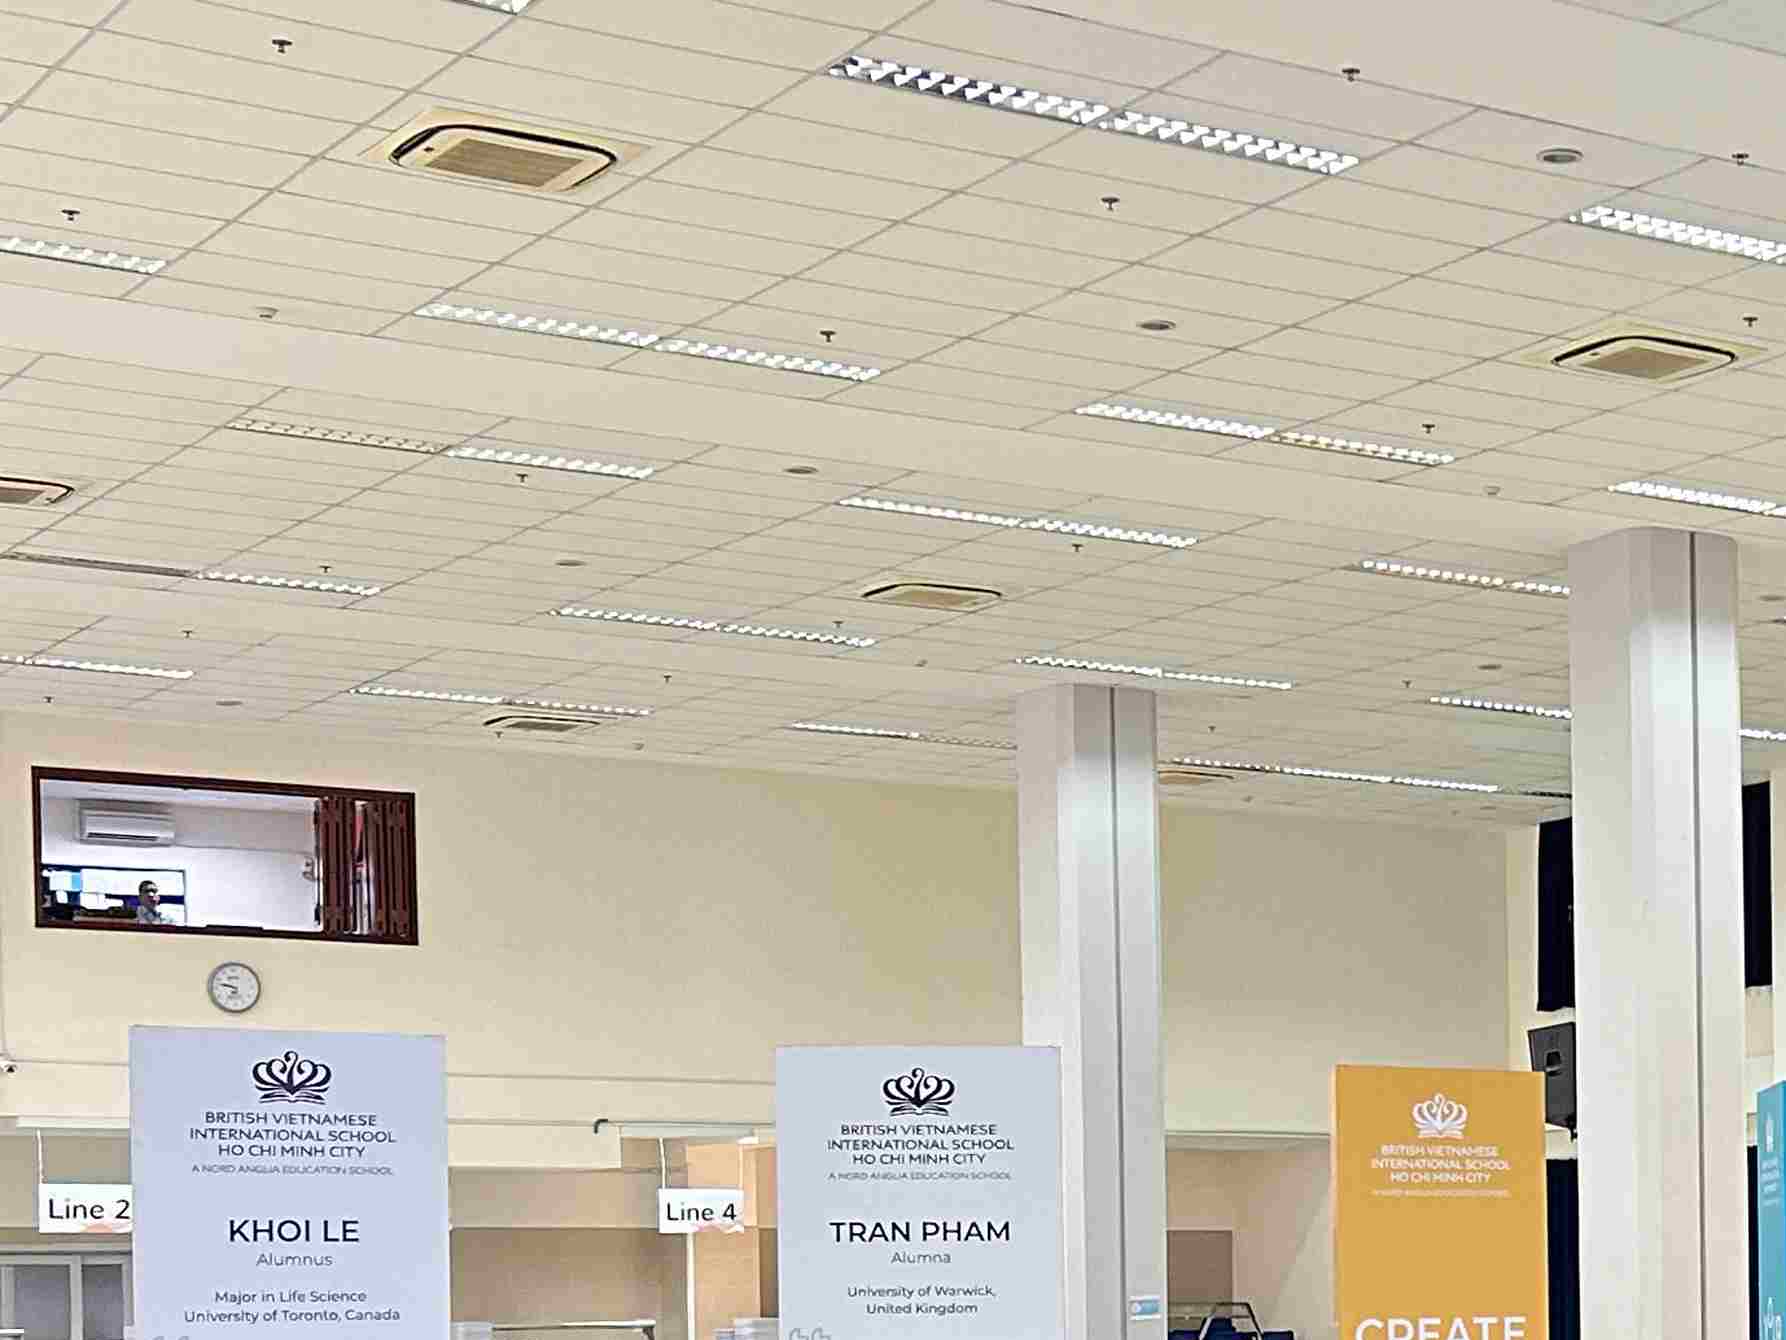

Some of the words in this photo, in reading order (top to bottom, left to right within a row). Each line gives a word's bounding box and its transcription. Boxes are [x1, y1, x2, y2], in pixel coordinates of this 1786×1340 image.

[205, 1111, 268, 1125] BRITISH
[272, 1113, 377, 1126] VIETNAMESE
[190, 1128, 325, 1141] INTERNATIONAL
[328, 1130, 398, 1143] SCHOOL
[841, 1124, 897, 1135] BRITISH
[900, 1124, 998, 1136] VIETNAMESE
[218, 1144, 245, 1156] HO
[249, 1145, 277, 1156] CHI
[280, 1146, 325, 1157] MINH
[329, 1146, 366, 1158] CITY
[827, 1139, 949, 1150] INTERNATIONAL
[952, 1139, 1015, 1151] SCHOOL
[853, 1154, 876, 1165] HO
[880, 1154, 905, 1165] CHI
[909, 1154, 950, 1165] MINH
[952, 1153, 986, 1165] CITY
[48, 1197, 105, 1220] Line
[115, 1198, 131, 1220] 2
[666, 1202, 714, 1222] Line
[721, 1202, 738, 1221] 4
[229, 1220, 311, 1243] KHOI
[323, 1220, 361, 1243] LE
[830, 1222, 911, 1243] TRAN
[921, 1221, 1011, 1242] PHAM
[256, 1252, 334, 1267] Alumnus
[890, 1251, 952, 1265] Alumna
[214, 1291, 257, 1305] Major
[261, 1290, 276, 1302] in
[279, 1290, 306, 1303] Life
[310, 1290, 367, 1303] Science
[847, 1284, 914, 1299] University
[917, 1284, 932, 1298] of
[184, 1309, 259, 1324] University
[263, 1309, 278, 1322] of
[281, 1309, 342, 1323] Toronto,
[344, 1308, 401, 1321] Canada
[866, 1302, 912, 1314] United
[915, 1301, 978, 1317] Kingdom
